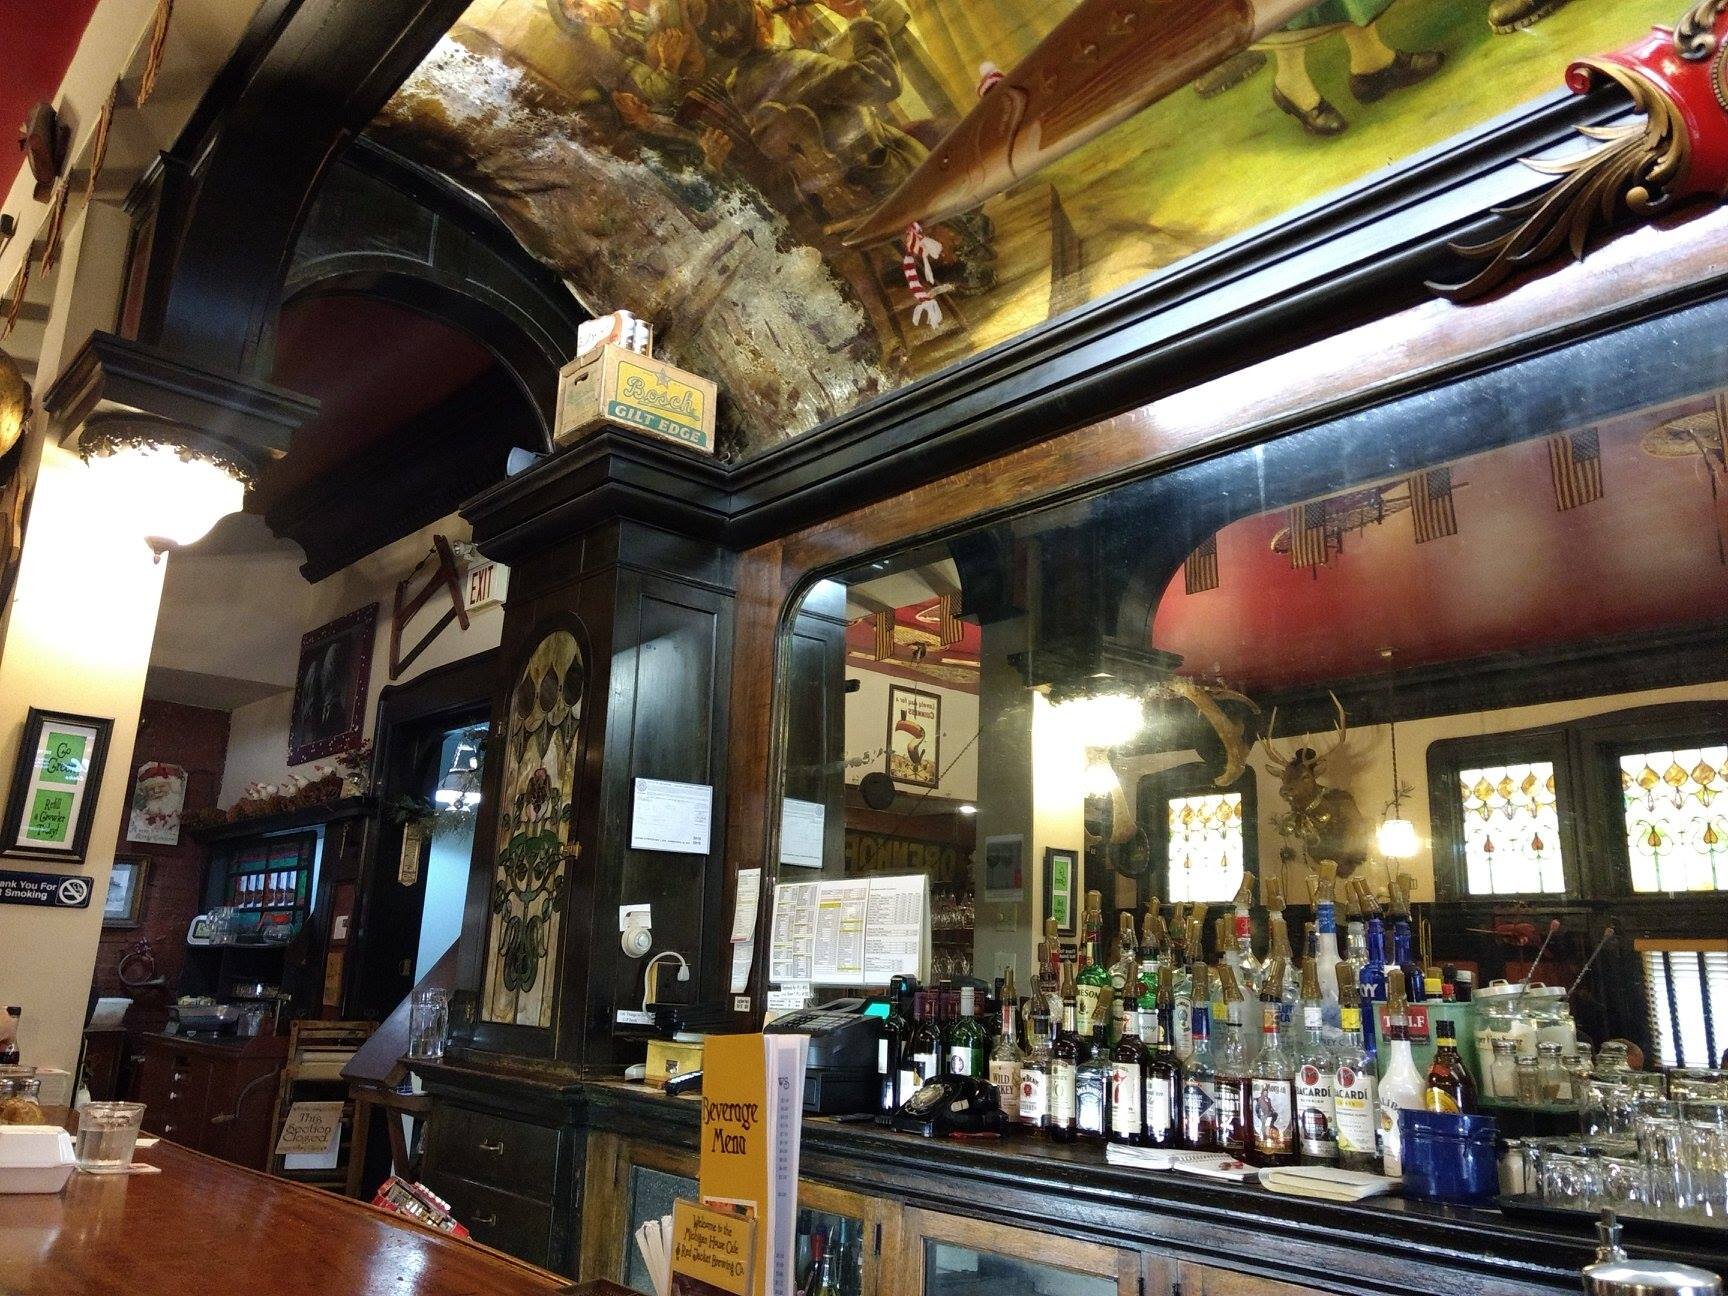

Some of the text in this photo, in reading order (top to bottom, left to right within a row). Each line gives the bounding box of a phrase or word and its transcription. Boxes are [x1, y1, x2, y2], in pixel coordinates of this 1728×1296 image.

[625, 376, 699, 420] Bosch
[616, 406, 701, 441] GILT EDGE
[470, 565, 494, 605] EXIT
[56, 742, 72, 759] Go
[0, 880, 57, 891] ank You For
[5, 888, 48, 900] Smoking
[300, 1112, 322, 1123] This
[703, 1096, 759, 1131] Beverage
[282, 1131, 329, 1142] Closed
[286, 1124, 331, 1135] Section
[711, 1127, 747, 1155] Menu
[692, 1214, 717, 1231] Welcome
